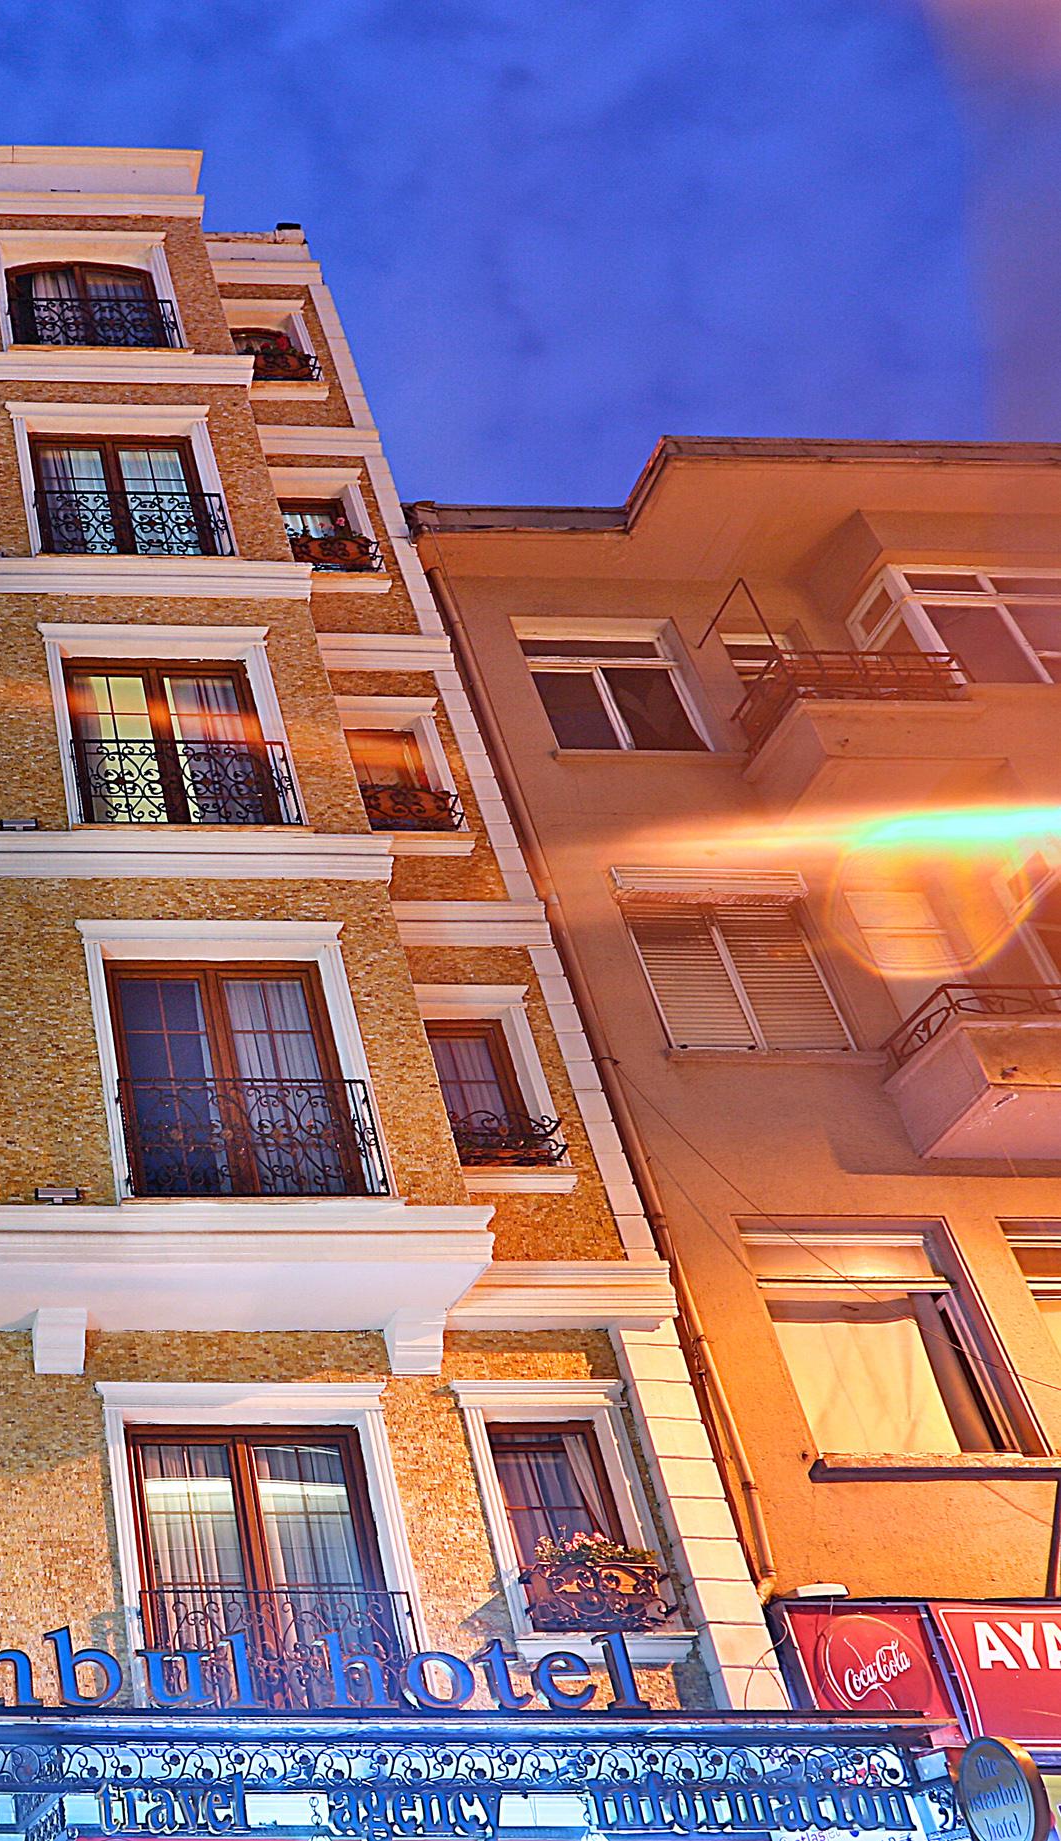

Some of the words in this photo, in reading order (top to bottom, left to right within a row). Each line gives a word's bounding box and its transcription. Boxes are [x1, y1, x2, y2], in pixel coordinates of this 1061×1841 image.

[315, 1631, 652, 1710] hotel
[976, 1754, 999, 1779] the
[96, 1772, 251, 1835] travel
[328, 1786, 502, 1841] agency
[587, 1771, 918, 1832] information
[984, 1812, 1022, 1841] hotel
